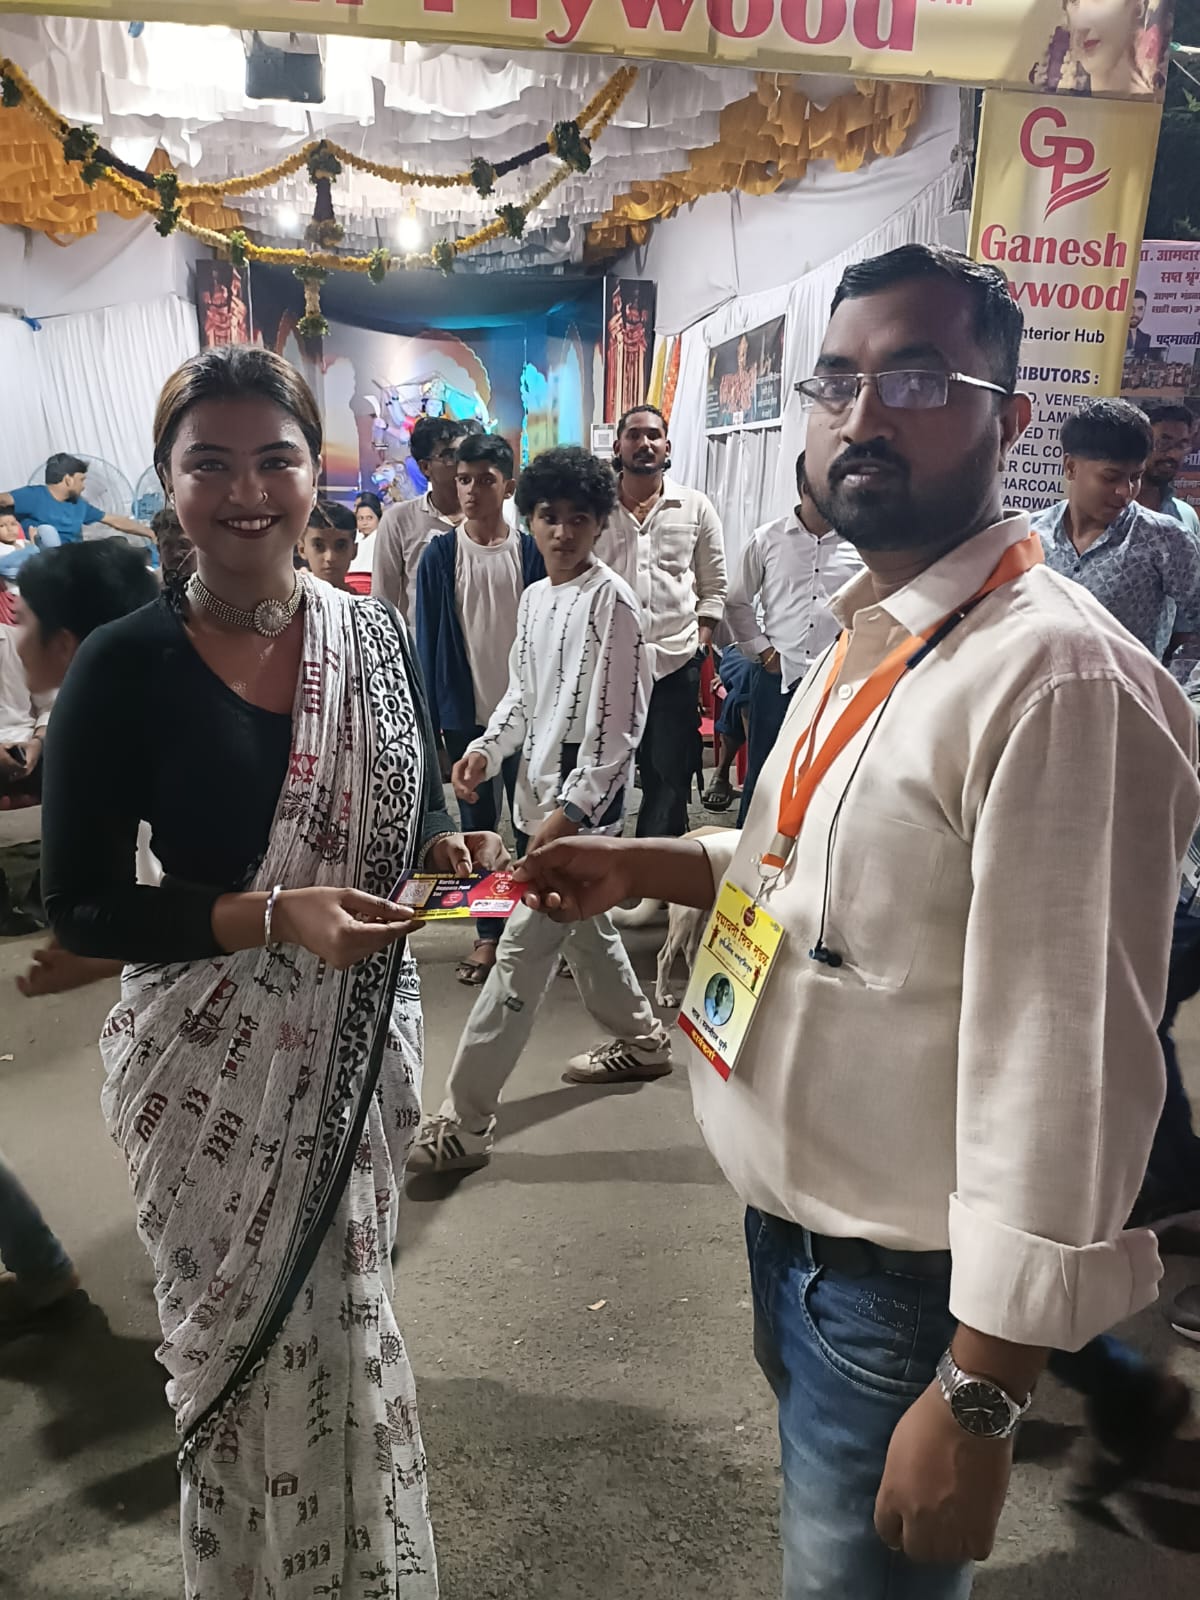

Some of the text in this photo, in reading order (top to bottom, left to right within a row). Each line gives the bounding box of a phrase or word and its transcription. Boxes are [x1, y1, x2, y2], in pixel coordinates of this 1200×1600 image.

[980, 224, 1128, 268] Ganesh
[1022, 327, 1105, 343] nterior Hub
[1016, 366, 1091, 384] RIBUTORS
[1039, 410, 1071, 423] LAM
[1024, 427, 1060, 440] ED TI
[1012, 443, 1063, 458] NEL CO
[1022, 461, 1064, 476] CUTTI
[1003, 478, 1064, 493] HARCOAL
[1002, 495, 1060, 509] ARDWA
